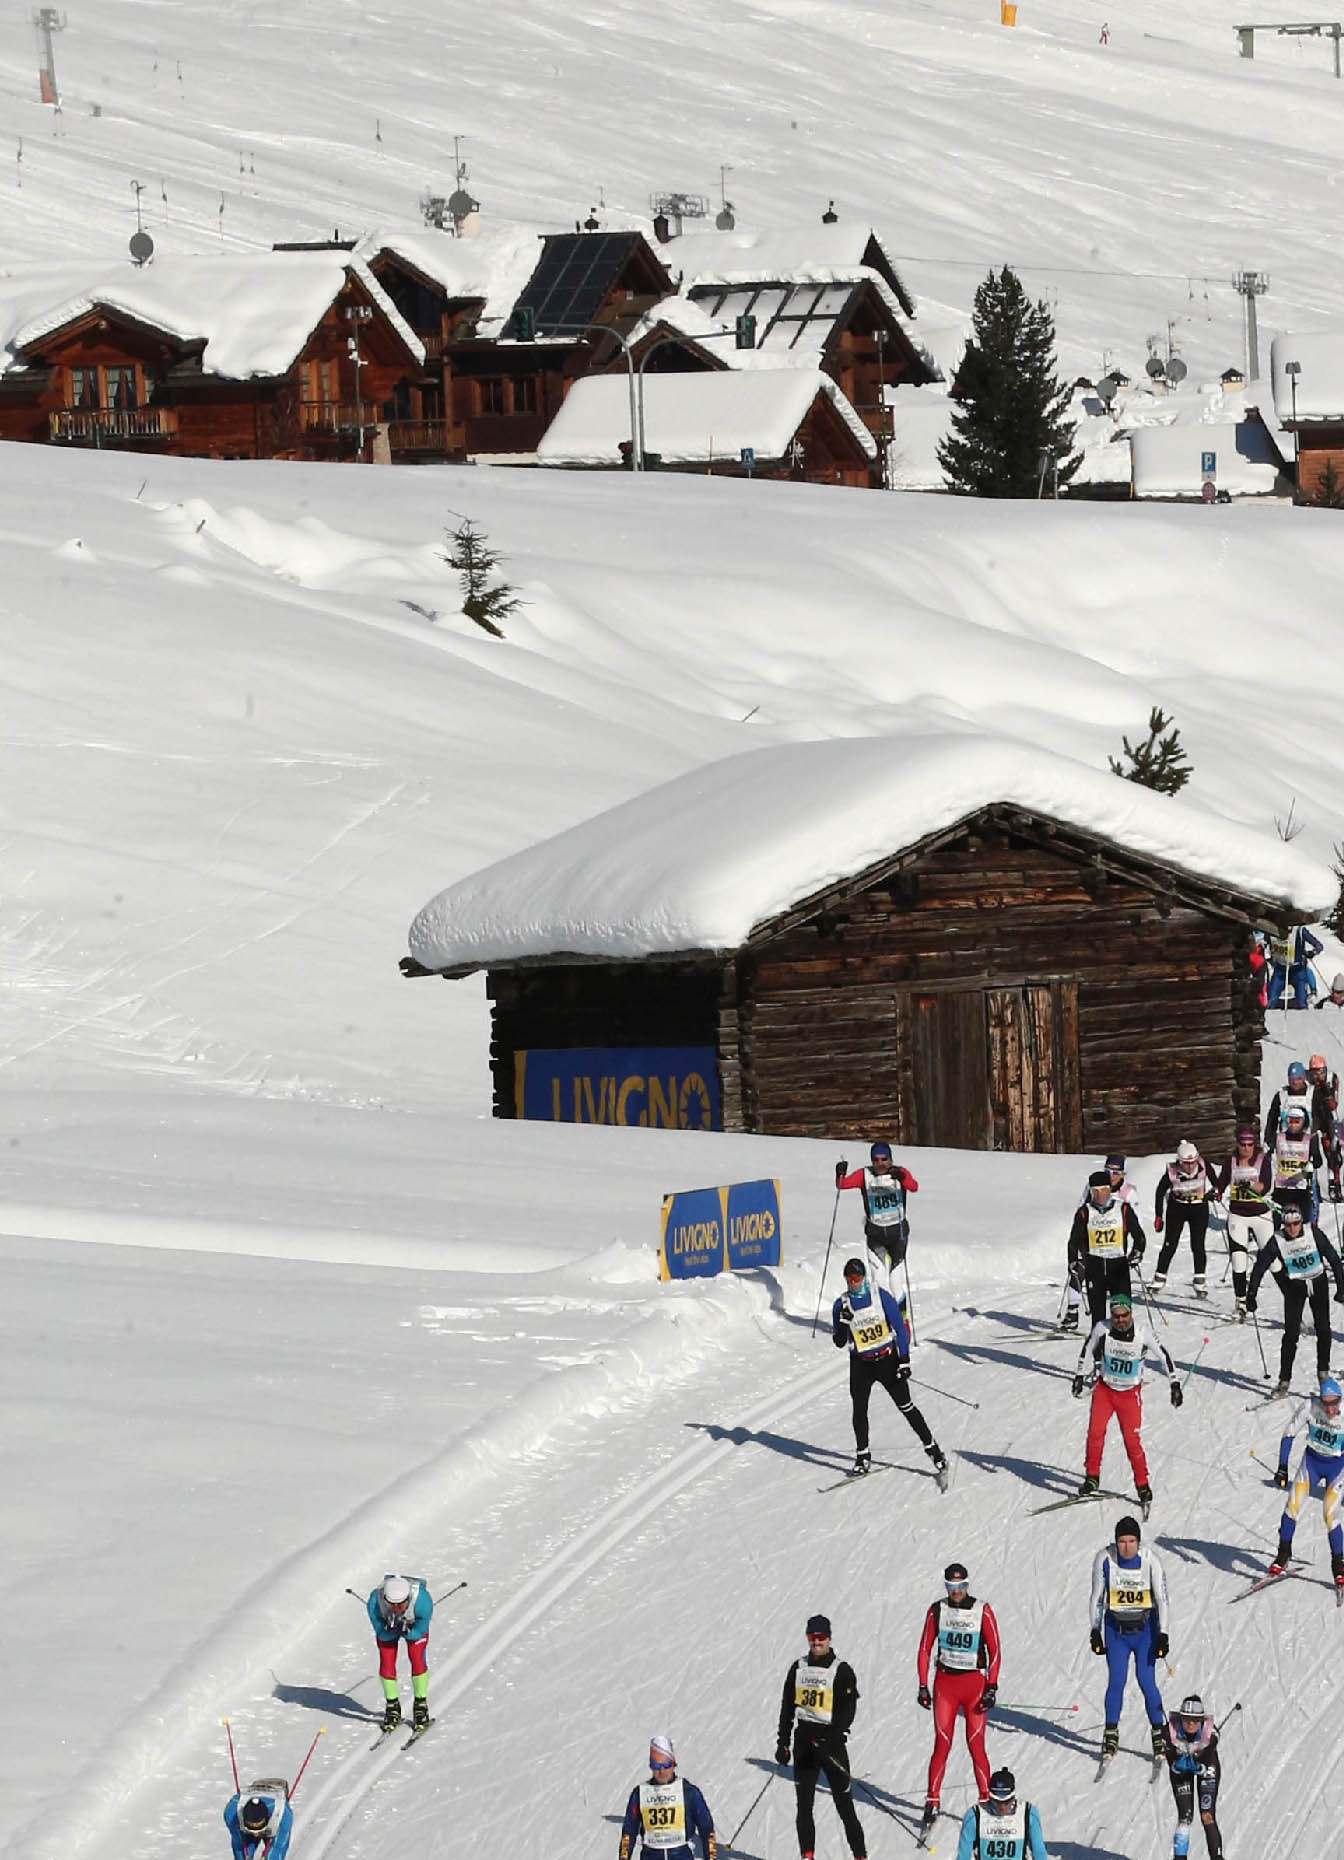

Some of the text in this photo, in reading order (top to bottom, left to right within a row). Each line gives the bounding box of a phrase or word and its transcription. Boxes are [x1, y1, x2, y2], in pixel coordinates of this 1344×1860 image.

[1204, 454, 1212, 470] P
[730, 1210, 775, 1245] LIVIGNO
[1095, 1229, 1116, 1244] 212
[674, 1220, 719, 1255] LIVIGNO
[857, 1323, 885, 1345] 339
[1109, 1359, 1133, 1375] 570
[946, 1631, 973, 1649] 449
[801, 1689, 825, 1708] 381
[648, 1807, 677, 1827] 337
[986, 1839, 1016, 1859] 430
